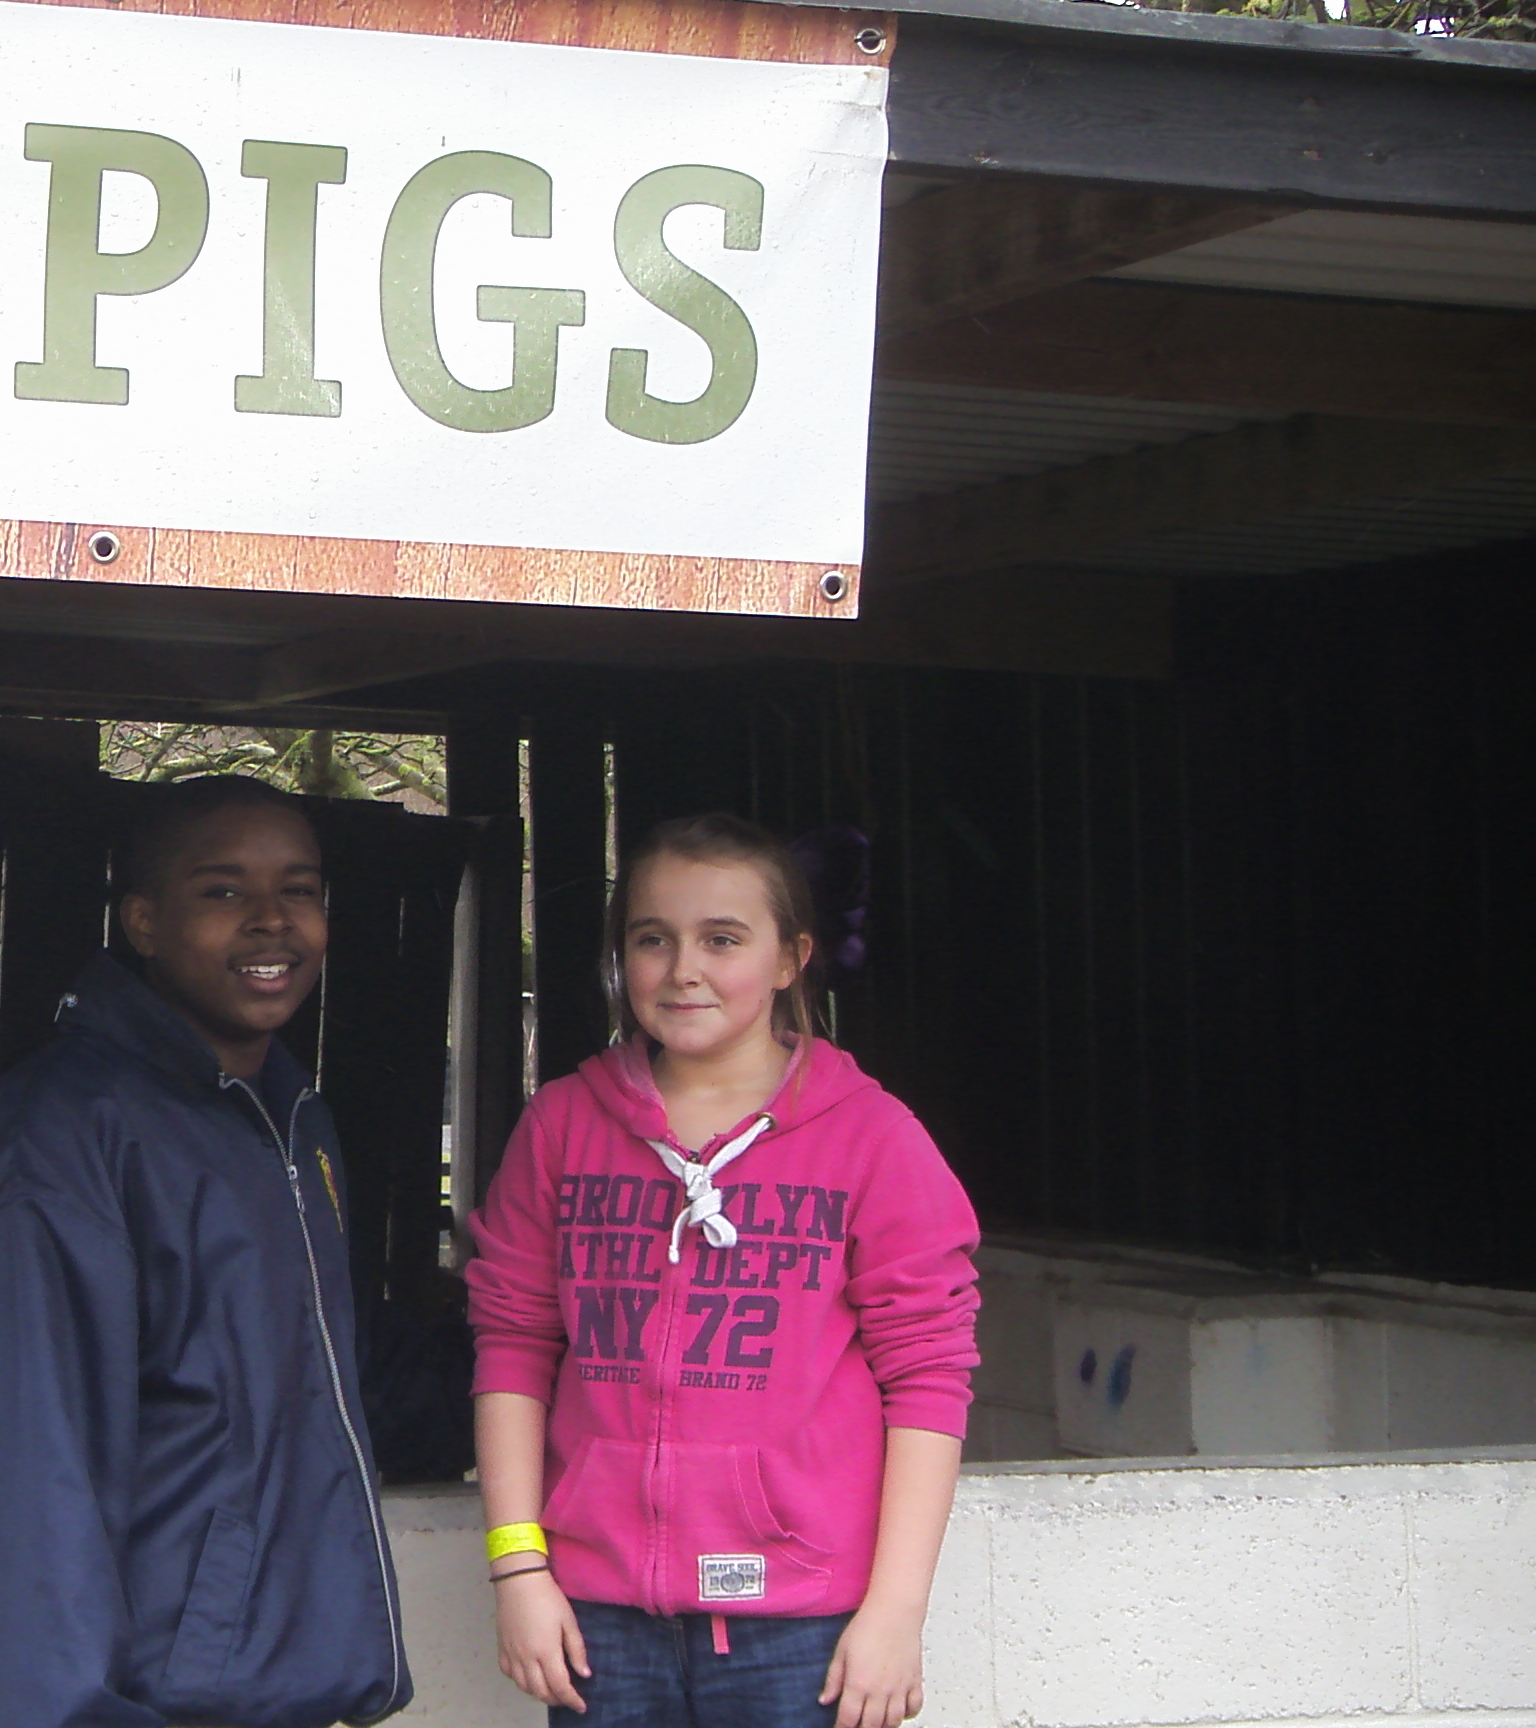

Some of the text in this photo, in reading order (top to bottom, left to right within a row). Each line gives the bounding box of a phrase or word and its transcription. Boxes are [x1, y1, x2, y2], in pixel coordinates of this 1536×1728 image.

[14, 122, 765, 445] PIGS
[691, 1241, 831, 1291] DEPT
[574, 1286, 780, 1368] NY 72
[679, 1370, 740, 1390] BRAND
[746, 1374, 767, 1390] 72
